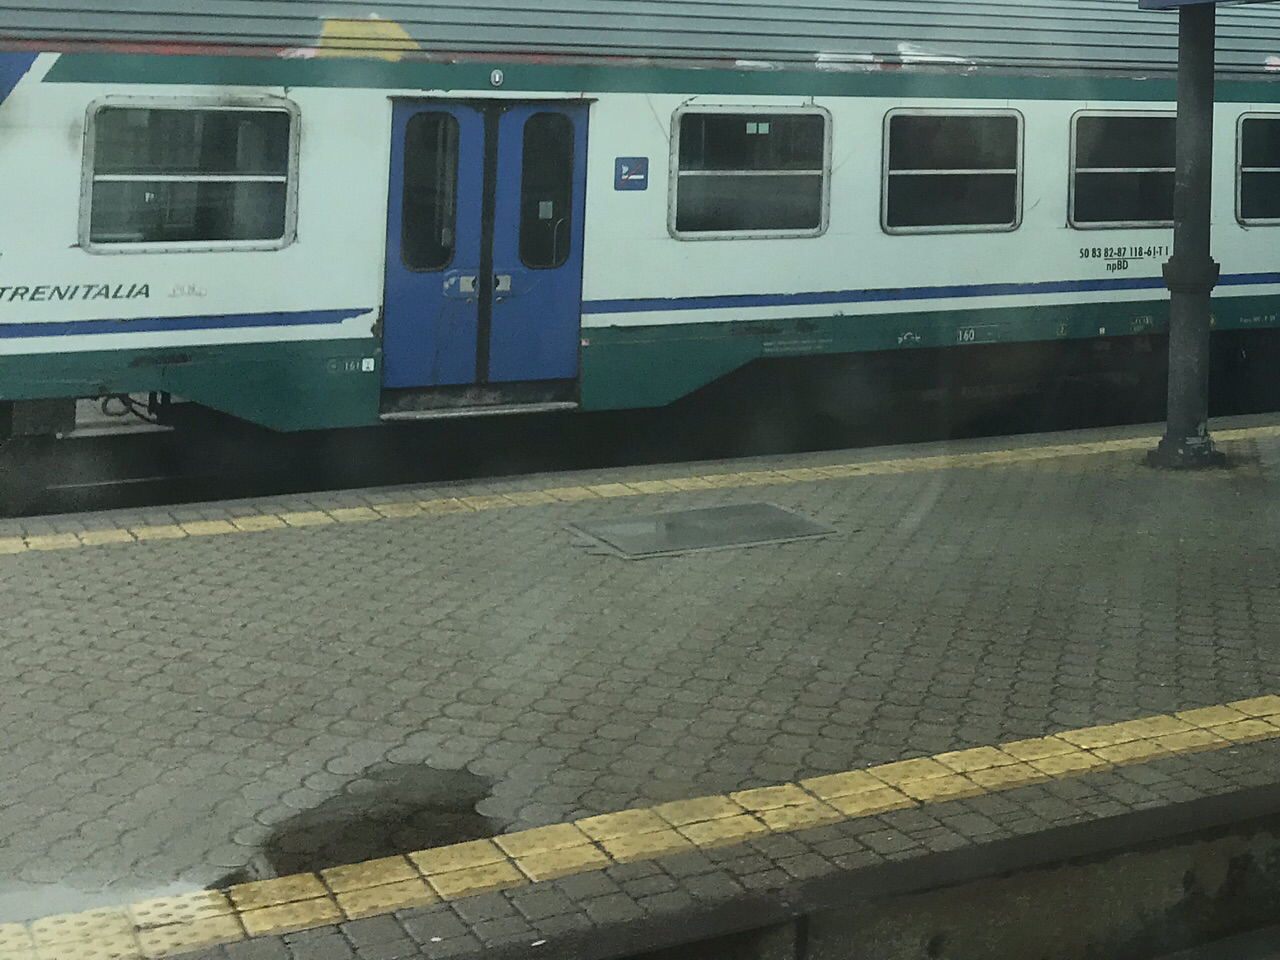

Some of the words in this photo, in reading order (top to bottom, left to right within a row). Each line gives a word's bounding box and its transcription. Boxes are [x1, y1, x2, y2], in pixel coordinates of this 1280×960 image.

[1079, 247, 1090, 258] 50
[1091, 247, 1102, 258] 83
[1103, 246, 1127, 258] 82-87
[1106, 259, 1129, 273] npBD
[0, 283, 151, 302] TRENITALIA
